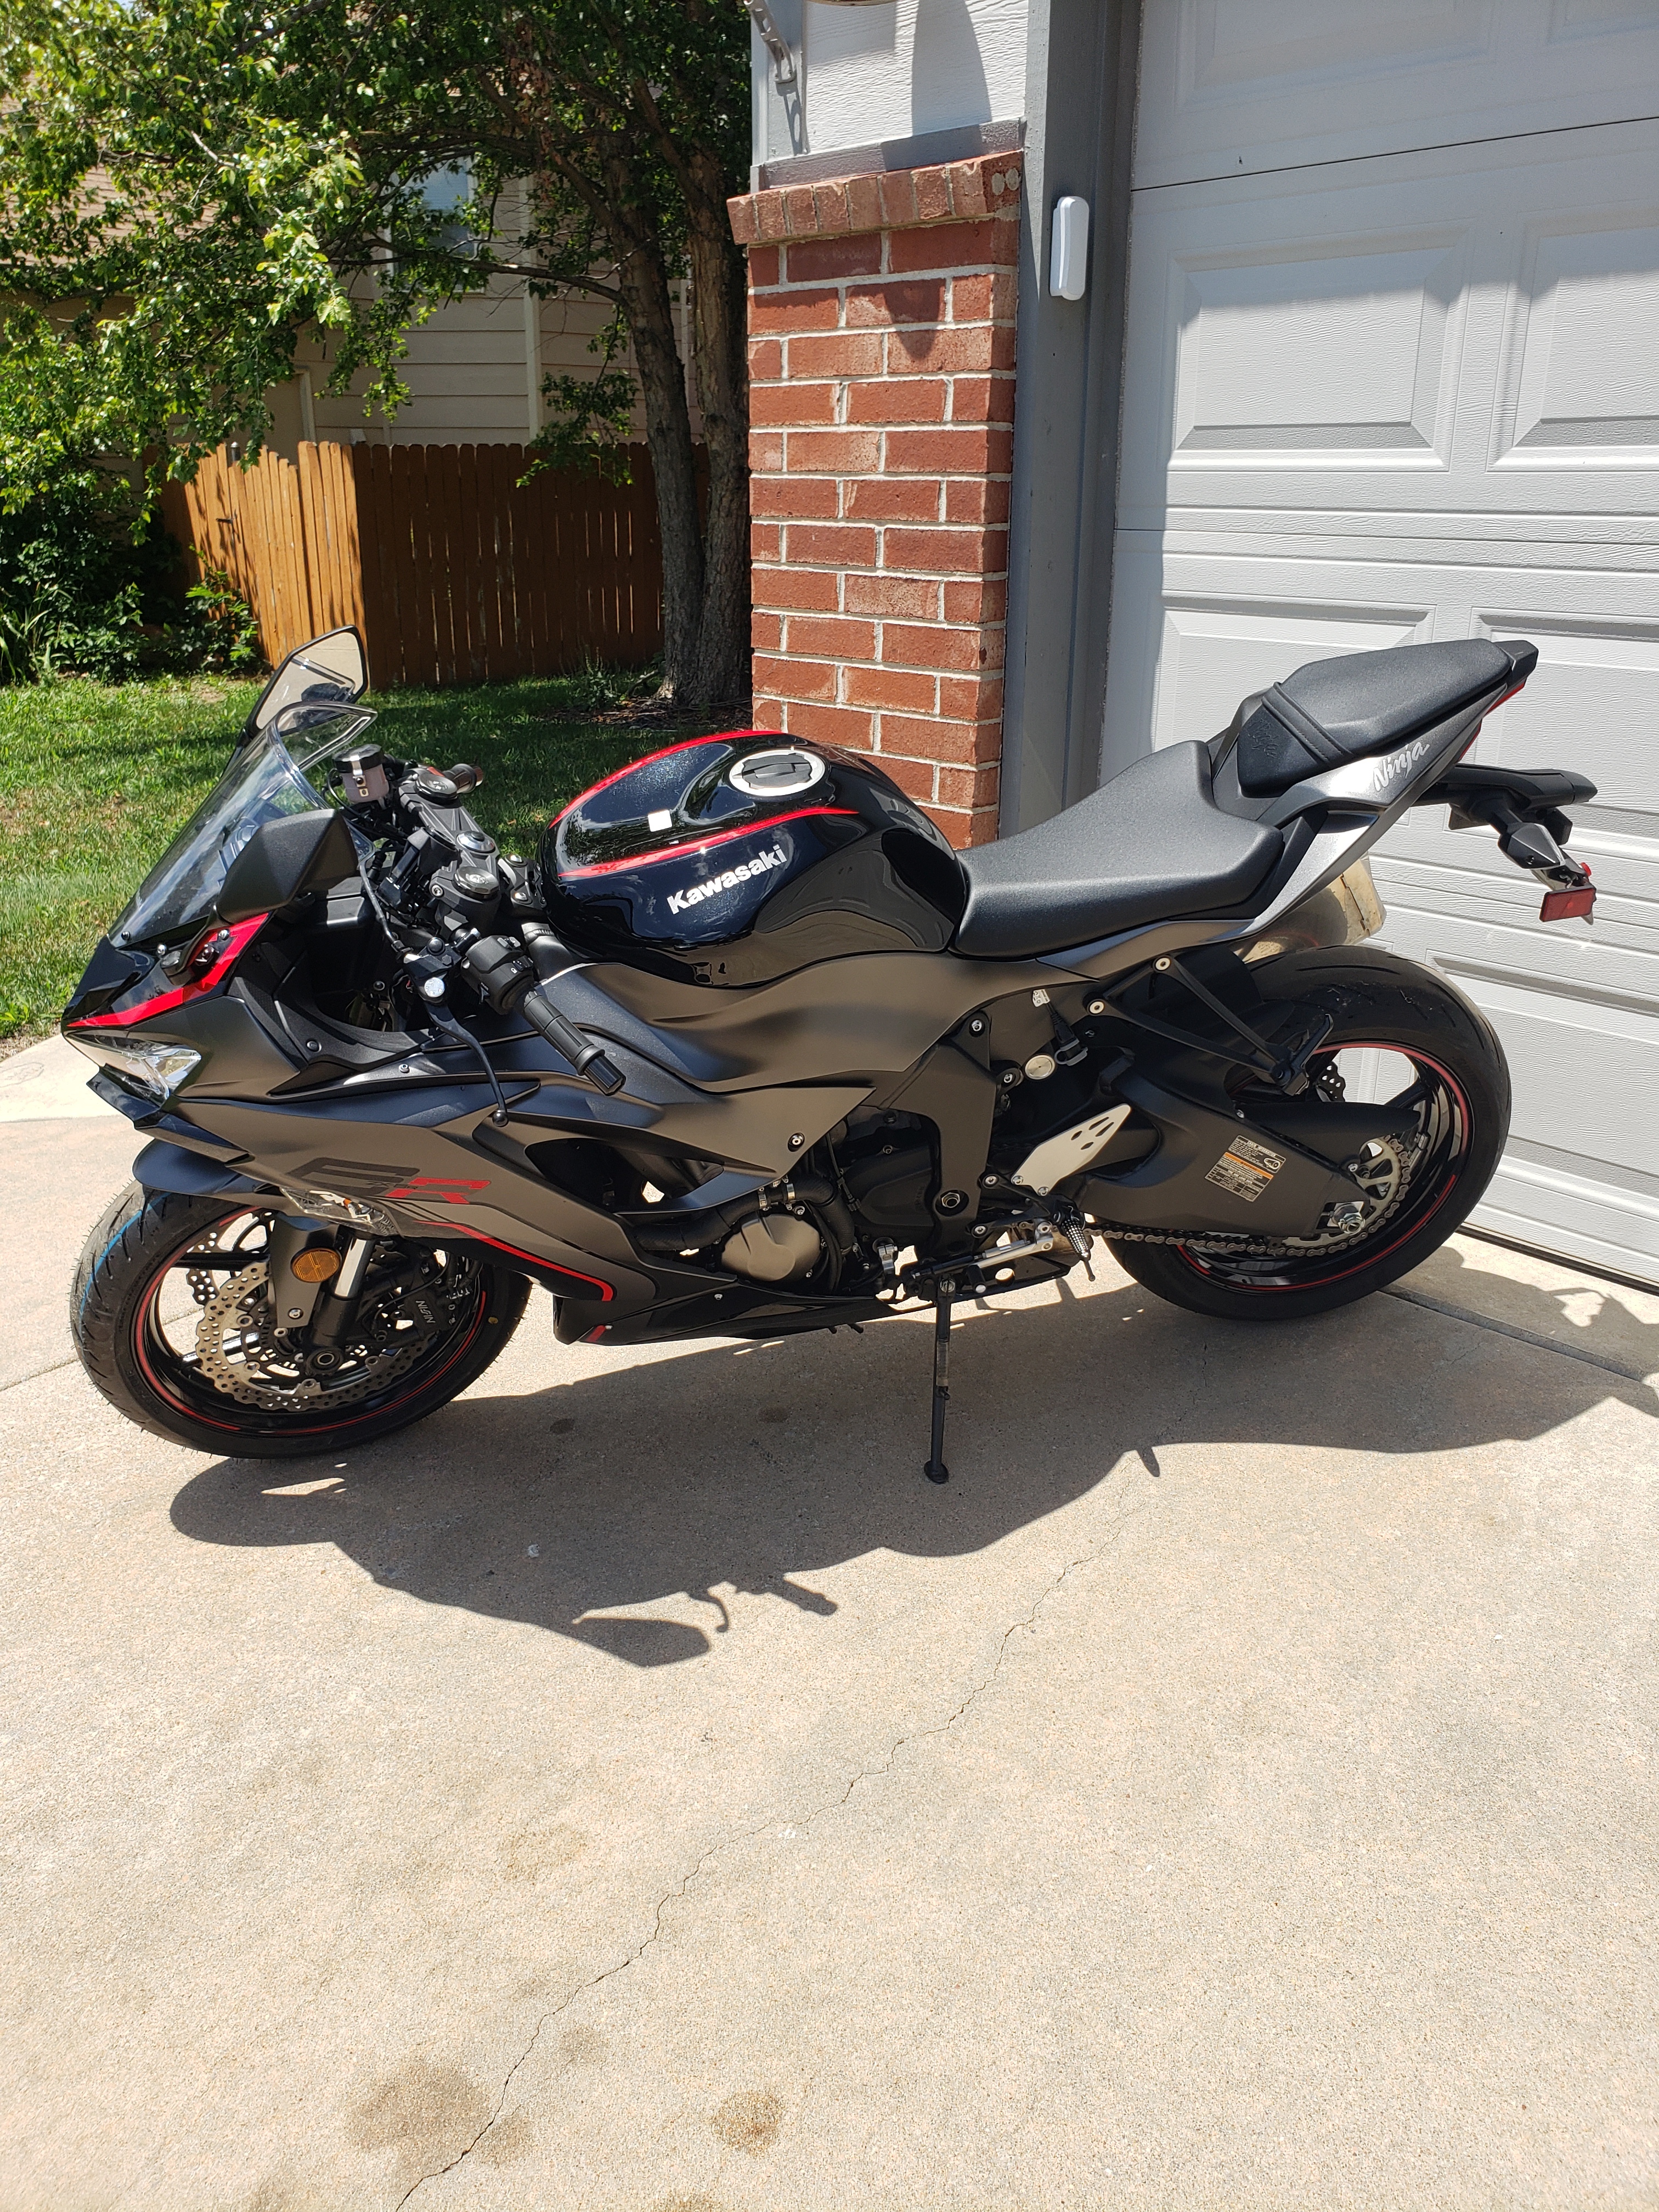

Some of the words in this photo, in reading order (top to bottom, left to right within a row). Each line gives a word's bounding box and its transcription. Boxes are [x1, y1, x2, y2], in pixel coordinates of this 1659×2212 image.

[1373, 741, 1430, 792] Ninja
[667, 844, 788, 915] Kawasaki
[415, 1300, 436, 1323] NISSIN
